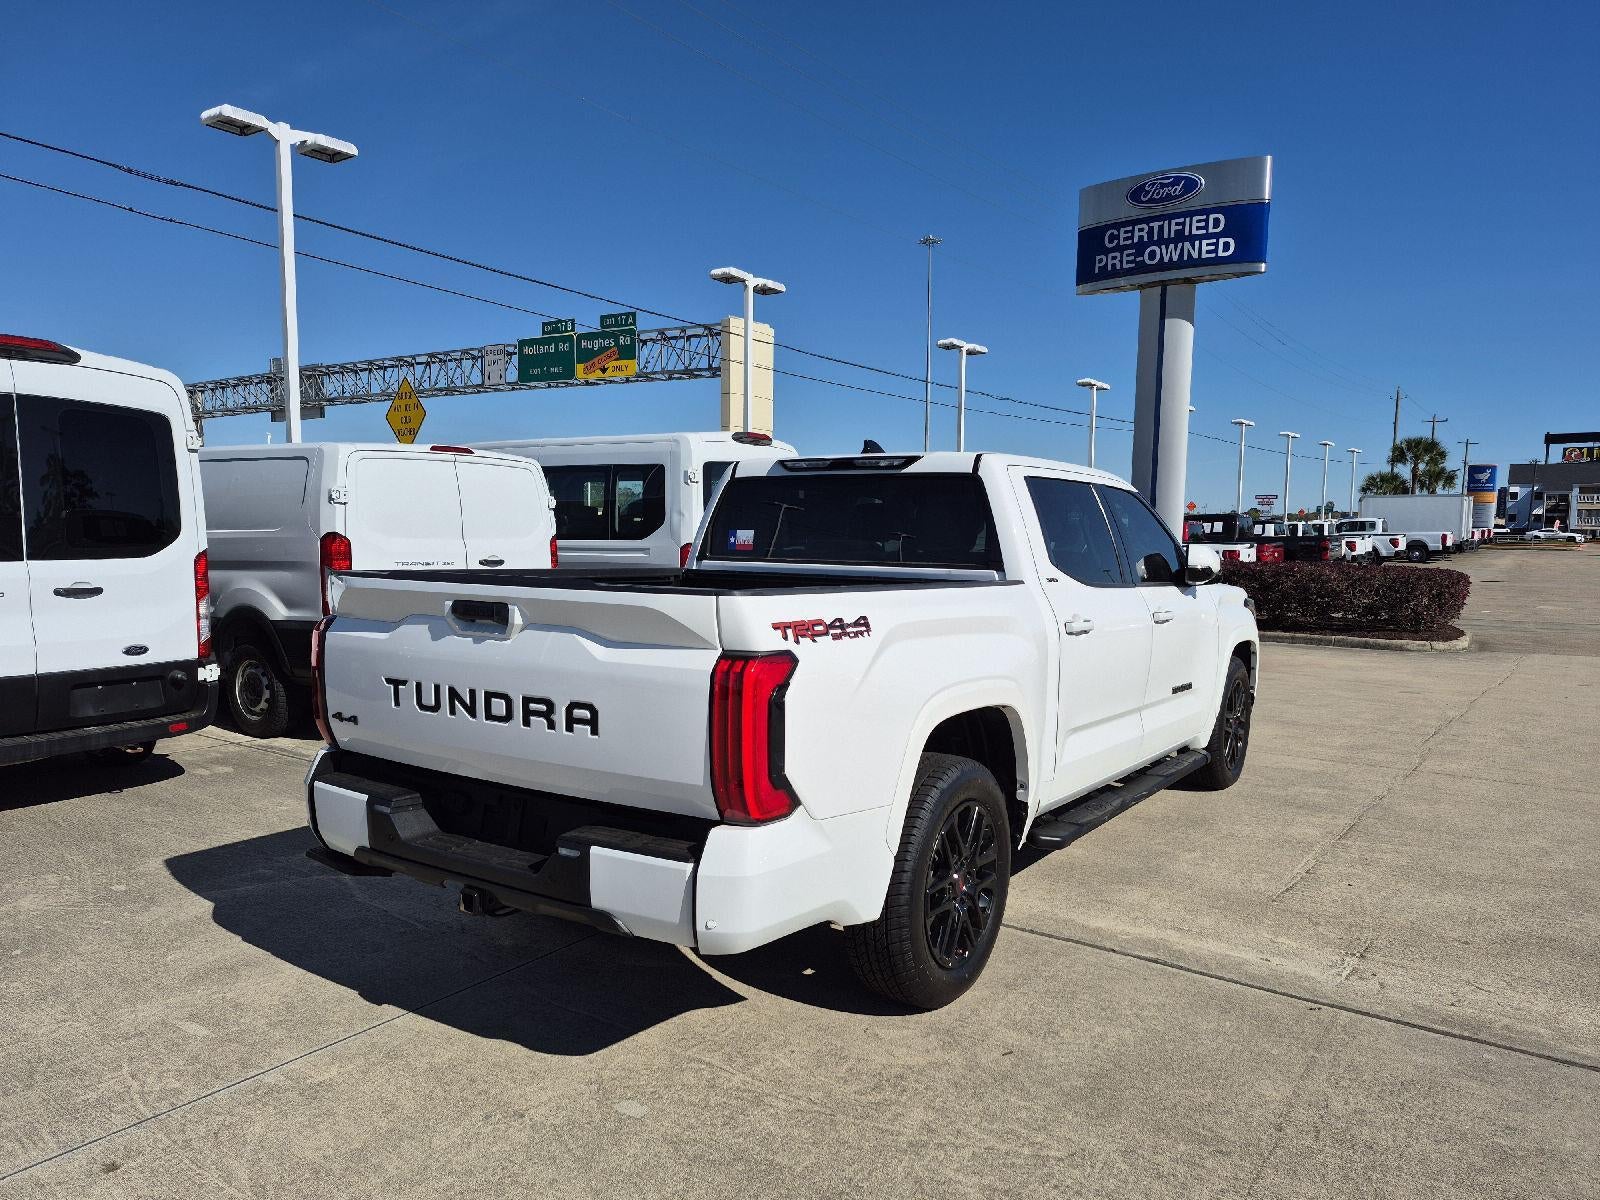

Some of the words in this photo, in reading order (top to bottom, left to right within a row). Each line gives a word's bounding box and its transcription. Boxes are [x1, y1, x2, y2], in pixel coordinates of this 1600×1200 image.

[1140, 178, 1185, 202] Ford
[1104, 213, 1226, 248] CERTIFIED
[1094, 237, 1236, 274] PRE-OWNED
[557, 322, 566, 332] 17
[617, 315, 627, 325] 17
[627, 314, 634, 325] A
[523, 342, 555, 355] Holland
[558, 341, 569, 352] Rd
[581, 337, 615, 351] Hughes
[619, 335, 631, 346] Rd
[611, 364, 629, 373] ONLY
[770, 619, 830, 645] TRD
[831, 629, 872, 641] SPORT
[382, 676, 600, 738] TUNDRA
